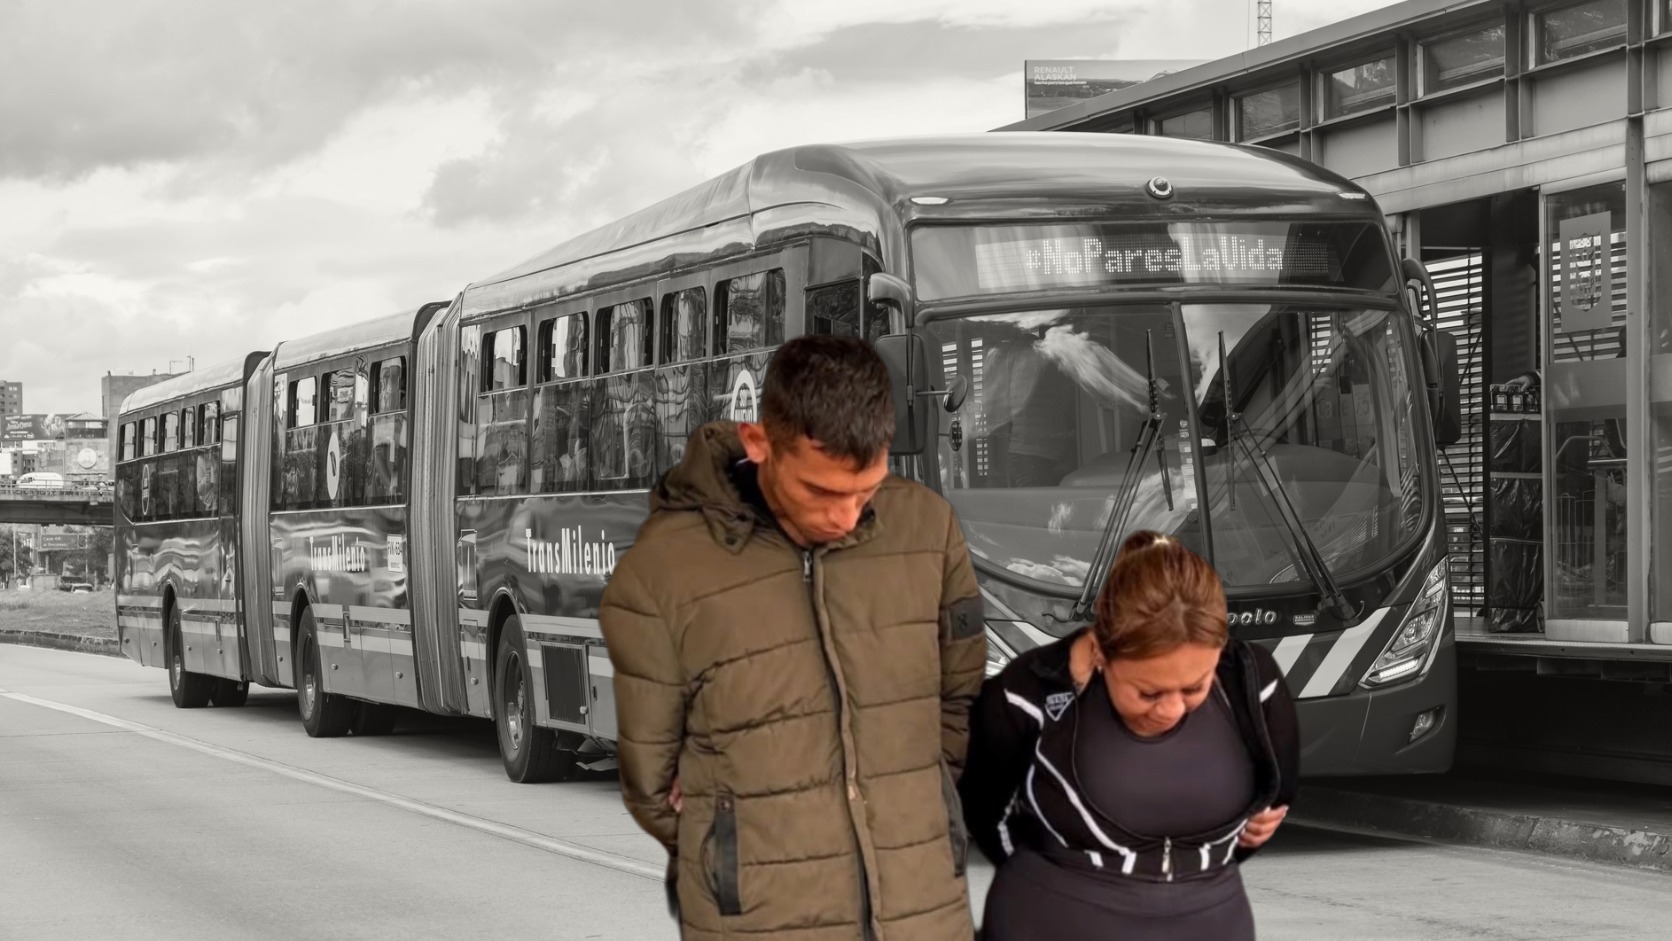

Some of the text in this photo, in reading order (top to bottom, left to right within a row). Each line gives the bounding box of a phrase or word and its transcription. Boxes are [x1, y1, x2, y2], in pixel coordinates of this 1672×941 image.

[1034, 66, 1074, 74] RENAULT
[1026, 236, 1284, 275] #NoParesLaVida
[309, 533, 365, 571] TransMilenio
[525, 524, 616, 576] TransMilenio
